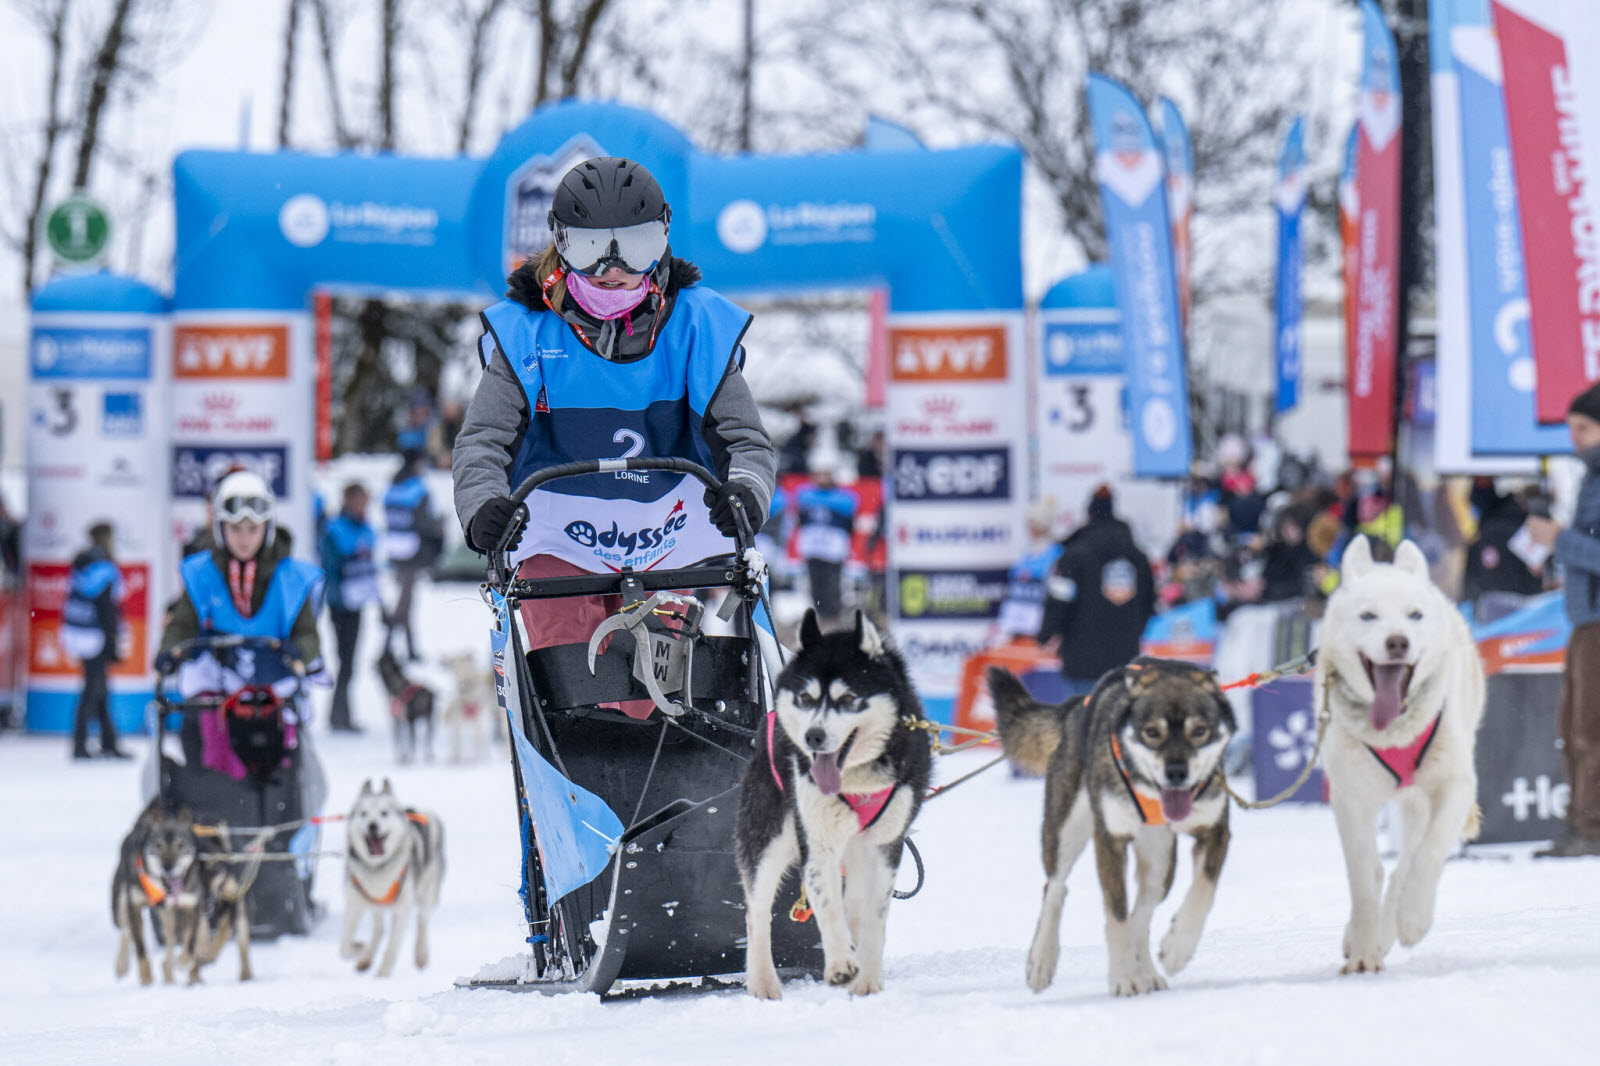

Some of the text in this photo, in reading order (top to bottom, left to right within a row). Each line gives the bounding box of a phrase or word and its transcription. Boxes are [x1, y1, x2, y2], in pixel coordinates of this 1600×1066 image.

[613, 428, 646, 473] 2
[615, 470, 650, 484] LORINE
[593, 536, 676, 567] des enfants
[655, 640, 671, 660] M
